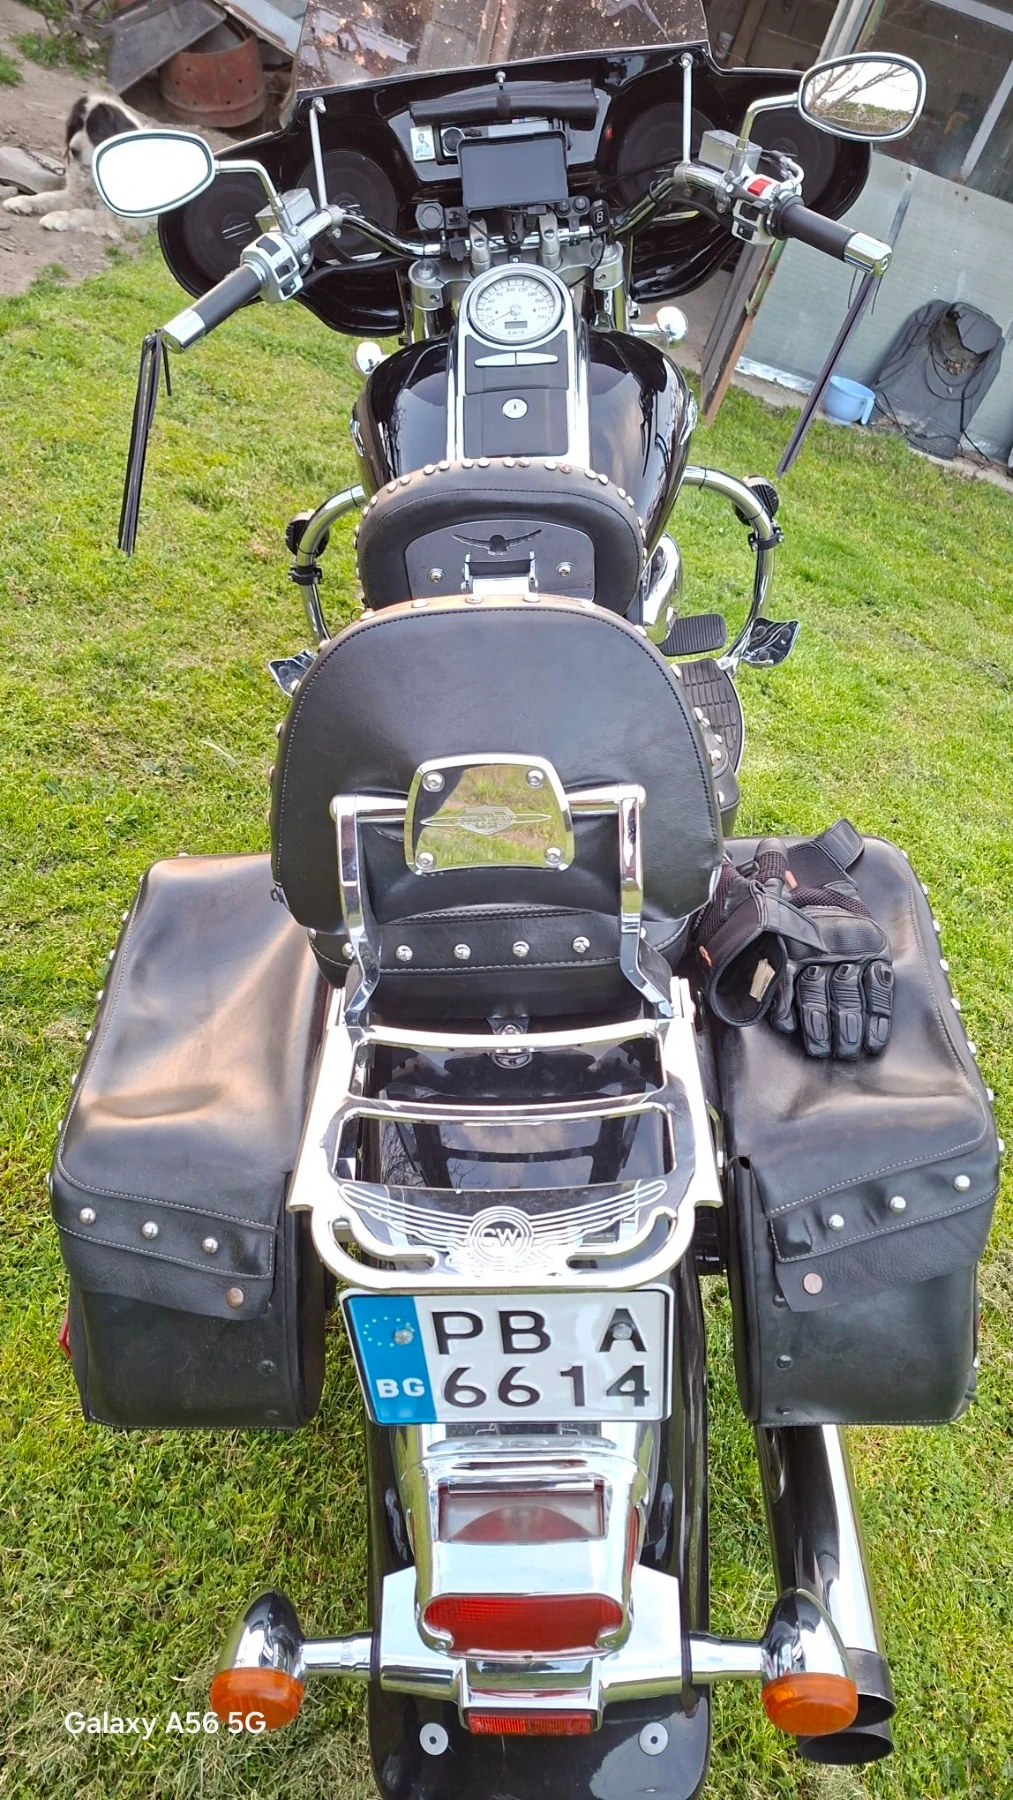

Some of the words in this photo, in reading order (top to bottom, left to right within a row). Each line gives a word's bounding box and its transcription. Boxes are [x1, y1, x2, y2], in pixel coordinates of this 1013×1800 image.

[431, 1309, 552, 1355] PB
[598, 1308, 648, 1353] A
[375, 1377, 425, 1399] BG
[443, 1365, 651, 1409] 6614
